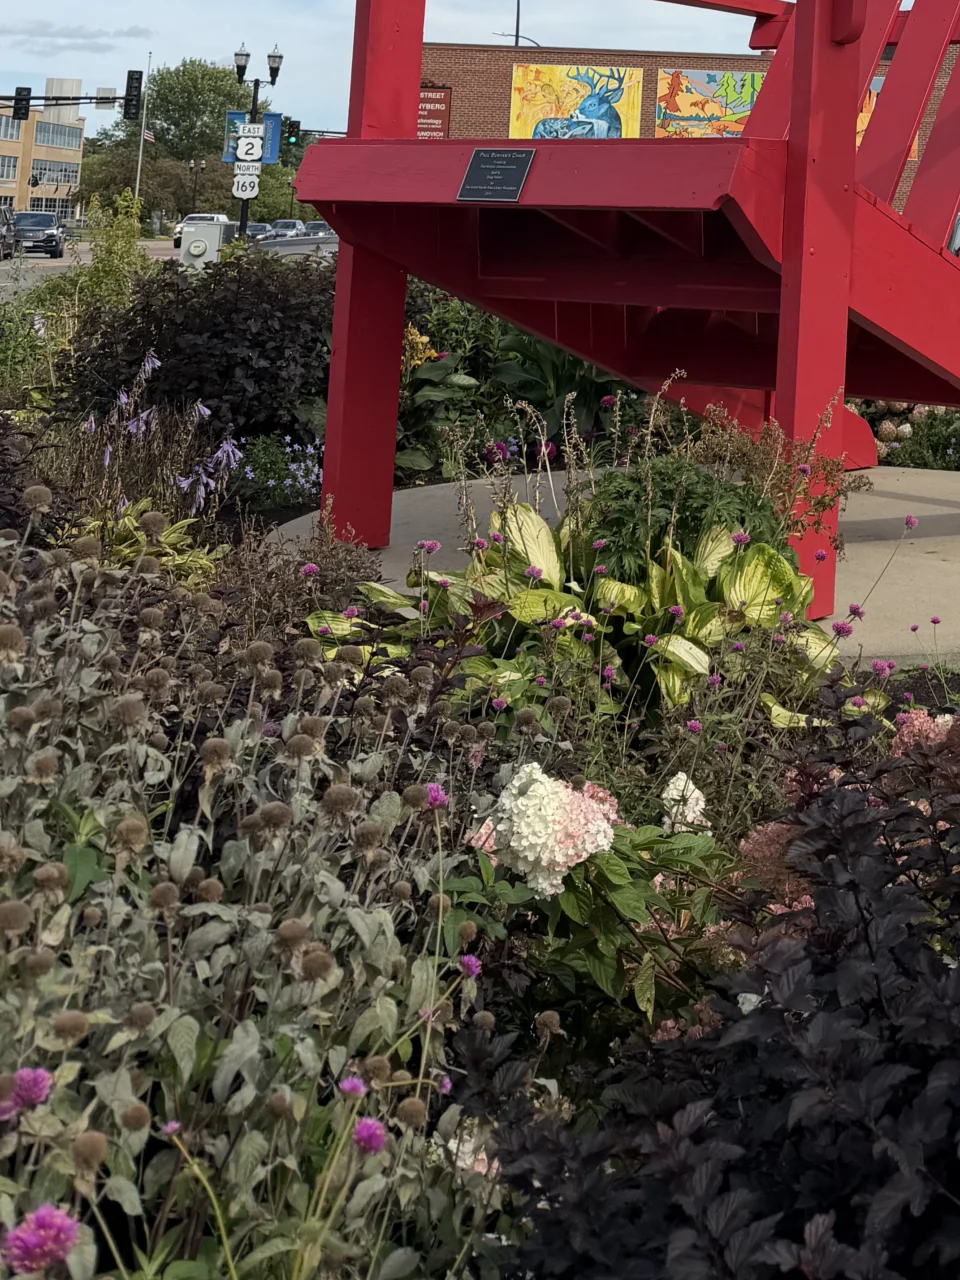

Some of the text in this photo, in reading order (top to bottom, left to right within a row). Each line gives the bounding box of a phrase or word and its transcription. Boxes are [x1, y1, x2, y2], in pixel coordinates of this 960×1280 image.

[244, 142, 255, 156] 2
[236, 164, 259, 173] NORTH
[236, 181, 256, 192] 169
